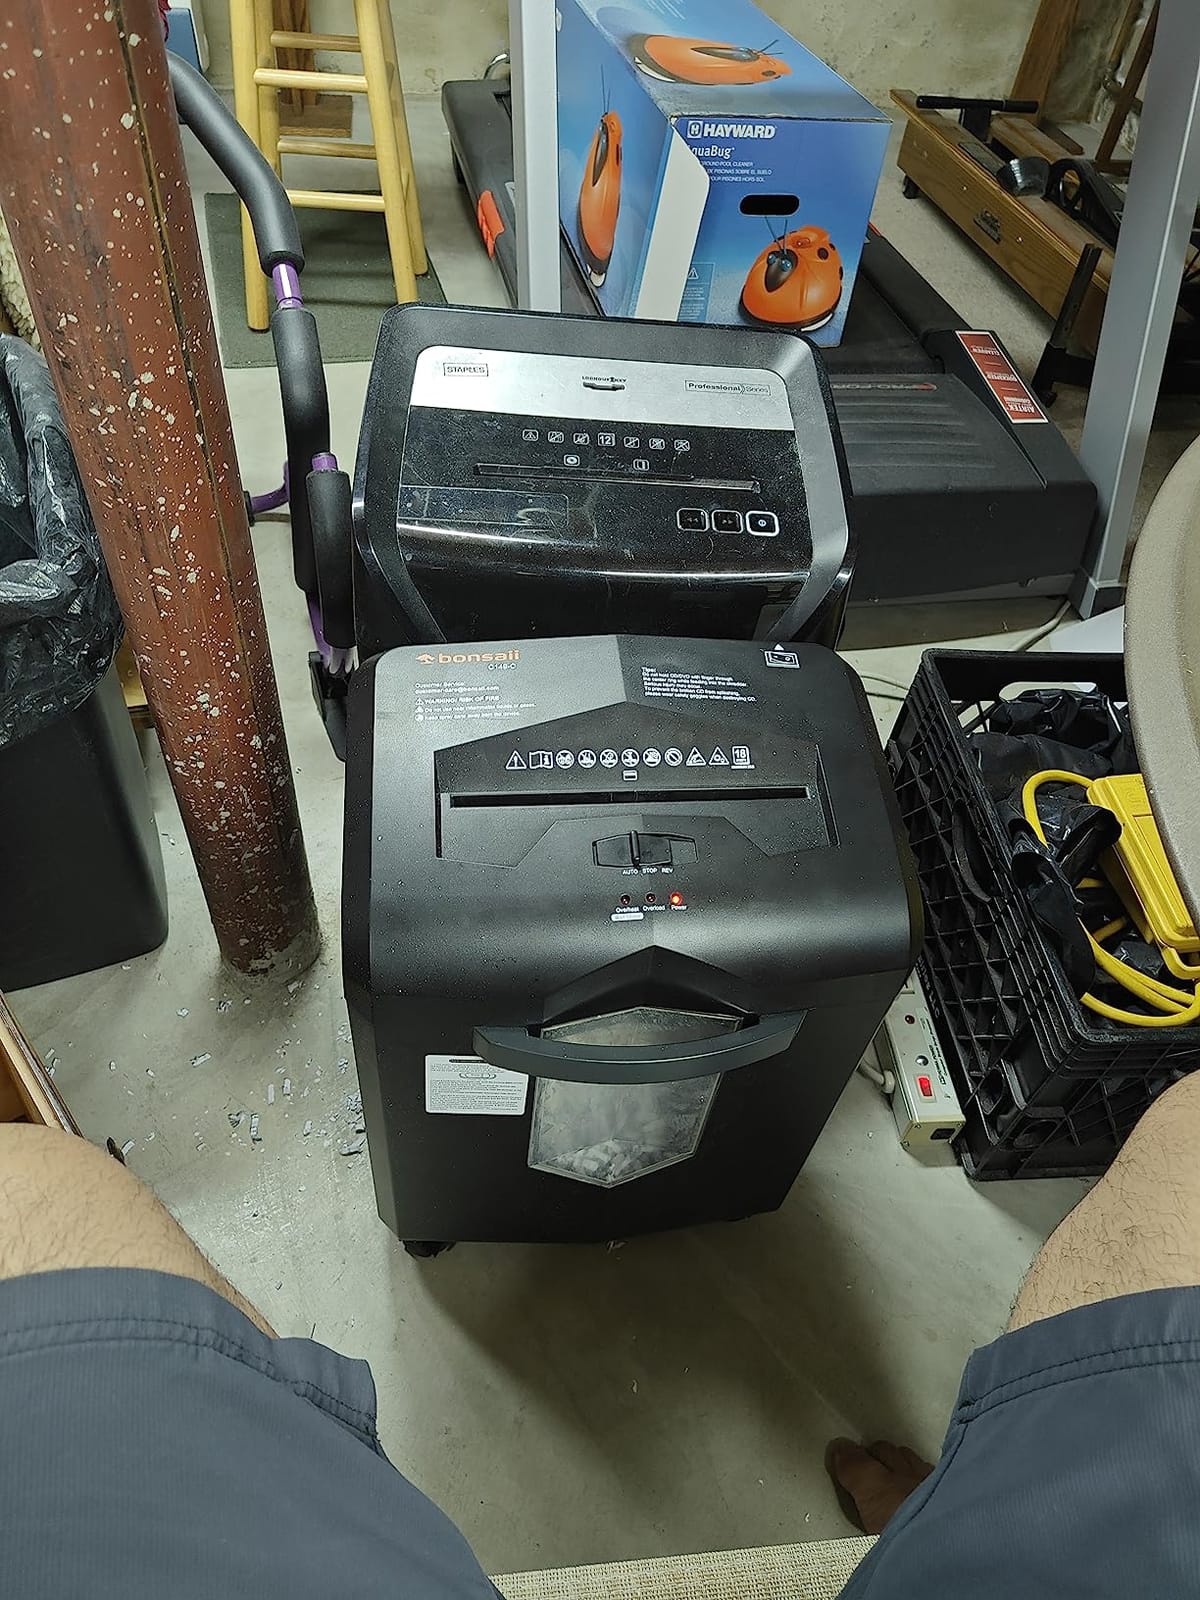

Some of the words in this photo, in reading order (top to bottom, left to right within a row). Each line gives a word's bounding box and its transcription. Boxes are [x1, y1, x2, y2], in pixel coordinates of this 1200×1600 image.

[703, 123, 776, 139] HAYWARD
[688, 144, 731, 160] quaBug
[446, 366, 486, 374] STAPLES
[688, 382, 742, 392] Professional
[745, 385, 769, 393] Series
[600, 435, 612, 445] 12
[438, 649, 520, 664] bonsaii
[735, 749, 746, 758] 18
